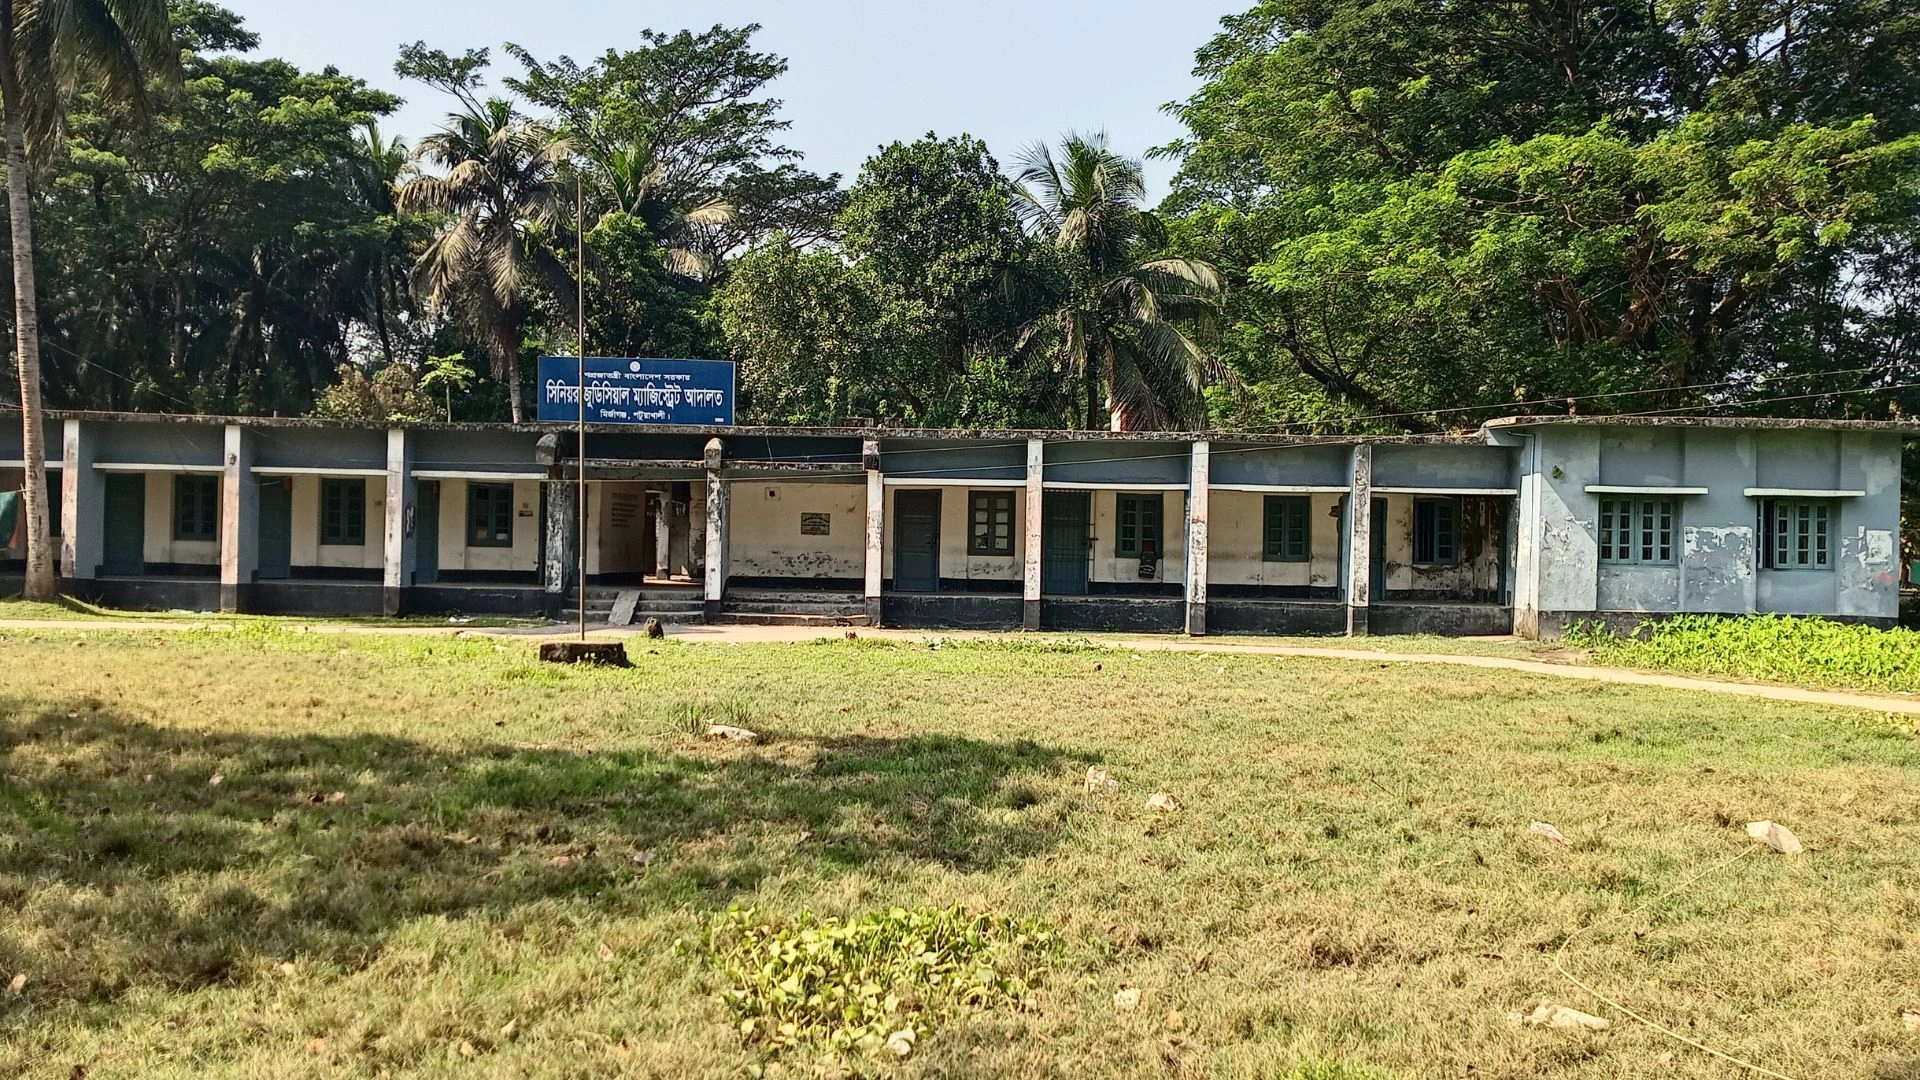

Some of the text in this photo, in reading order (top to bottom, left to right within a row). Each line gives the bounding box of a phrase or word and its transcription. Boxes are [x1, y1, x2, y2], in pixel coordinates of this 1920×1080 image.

[579, 371, 621, 381] ণপ্রজাতন্ত্রী
[545, 379, 580, 404] সিনিয়র
[633, 381, 682, 409] ম্যাজিস্ট্রেট
[684, 387, 724, 408] আদালত
